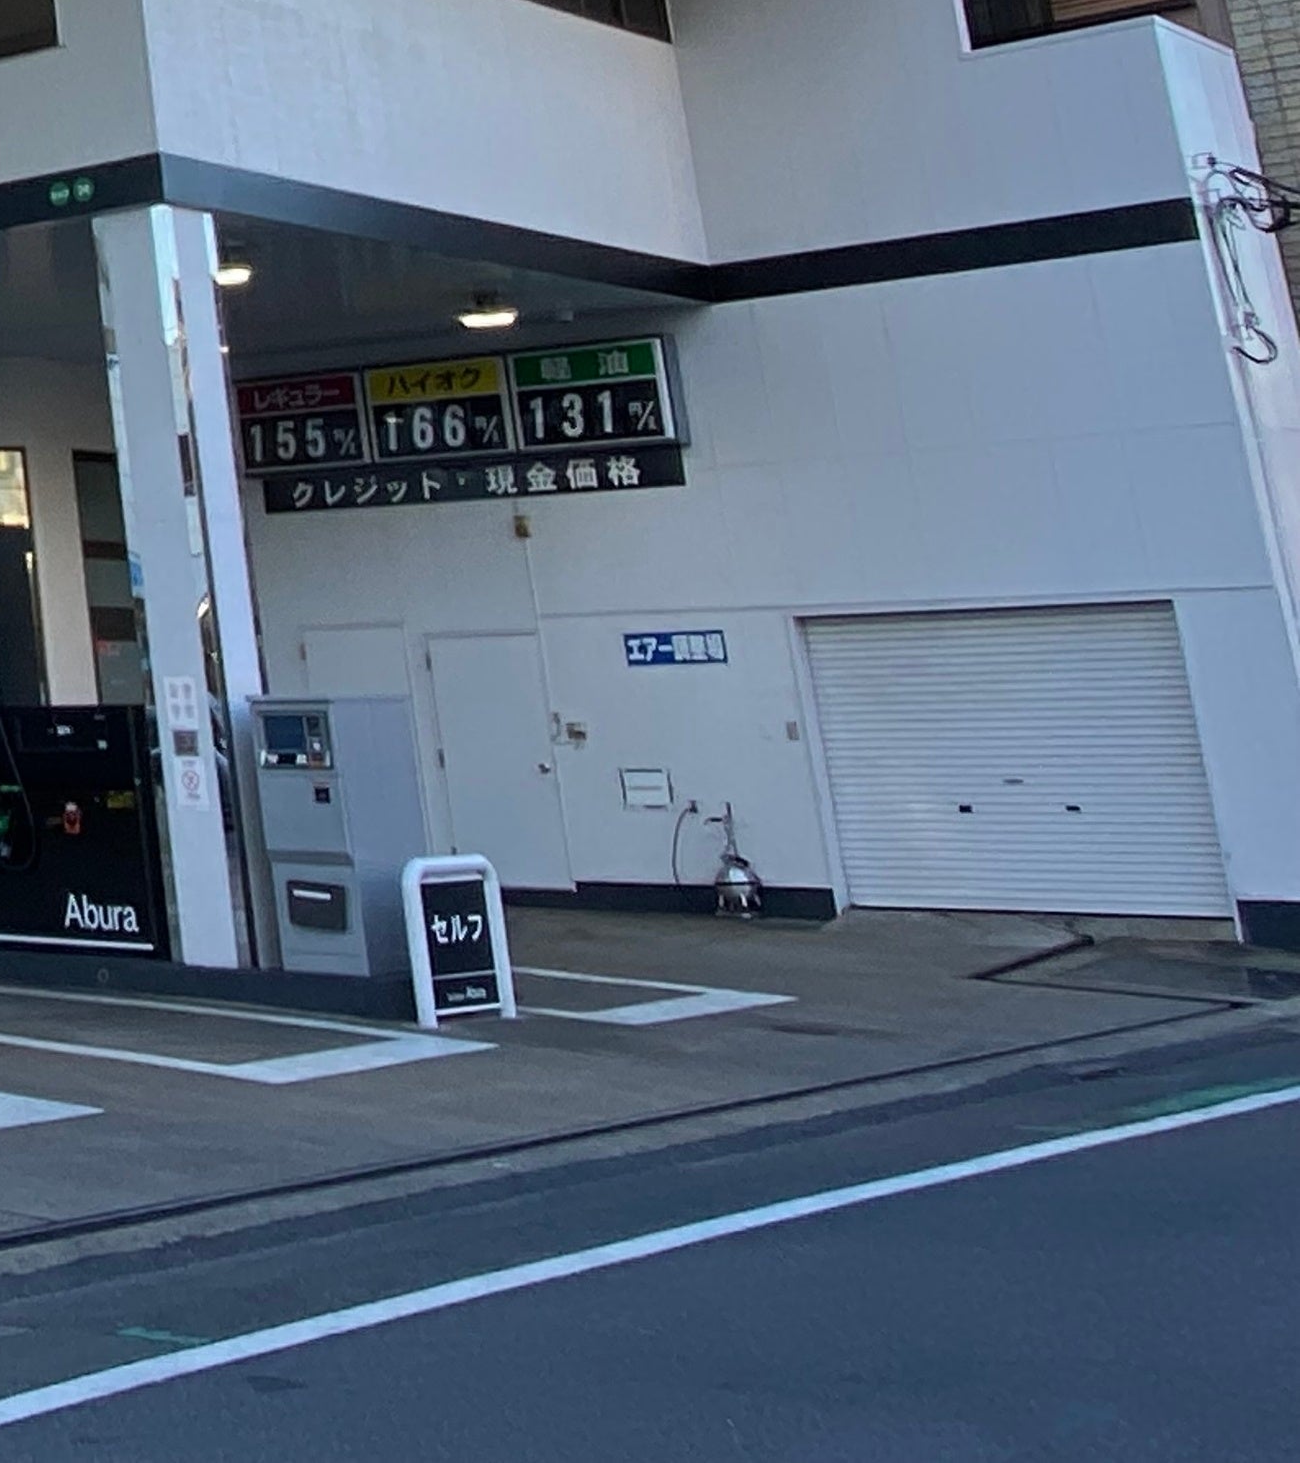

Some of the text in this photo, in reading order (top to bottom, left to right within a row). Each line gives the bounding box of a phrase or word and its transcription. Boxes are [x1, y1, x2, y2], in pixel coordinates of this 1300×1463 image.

[254, 385, 340, 410] レギュラー
[388, 367, 481, 394] ハイオク
[382, 404, 466, 452] 166
[530, 390, 613, 439] 131
[250, 418, 326, 463] 155
[64, 892, 139, 932] Abura
[431, 914, 482, 944] セルフ
